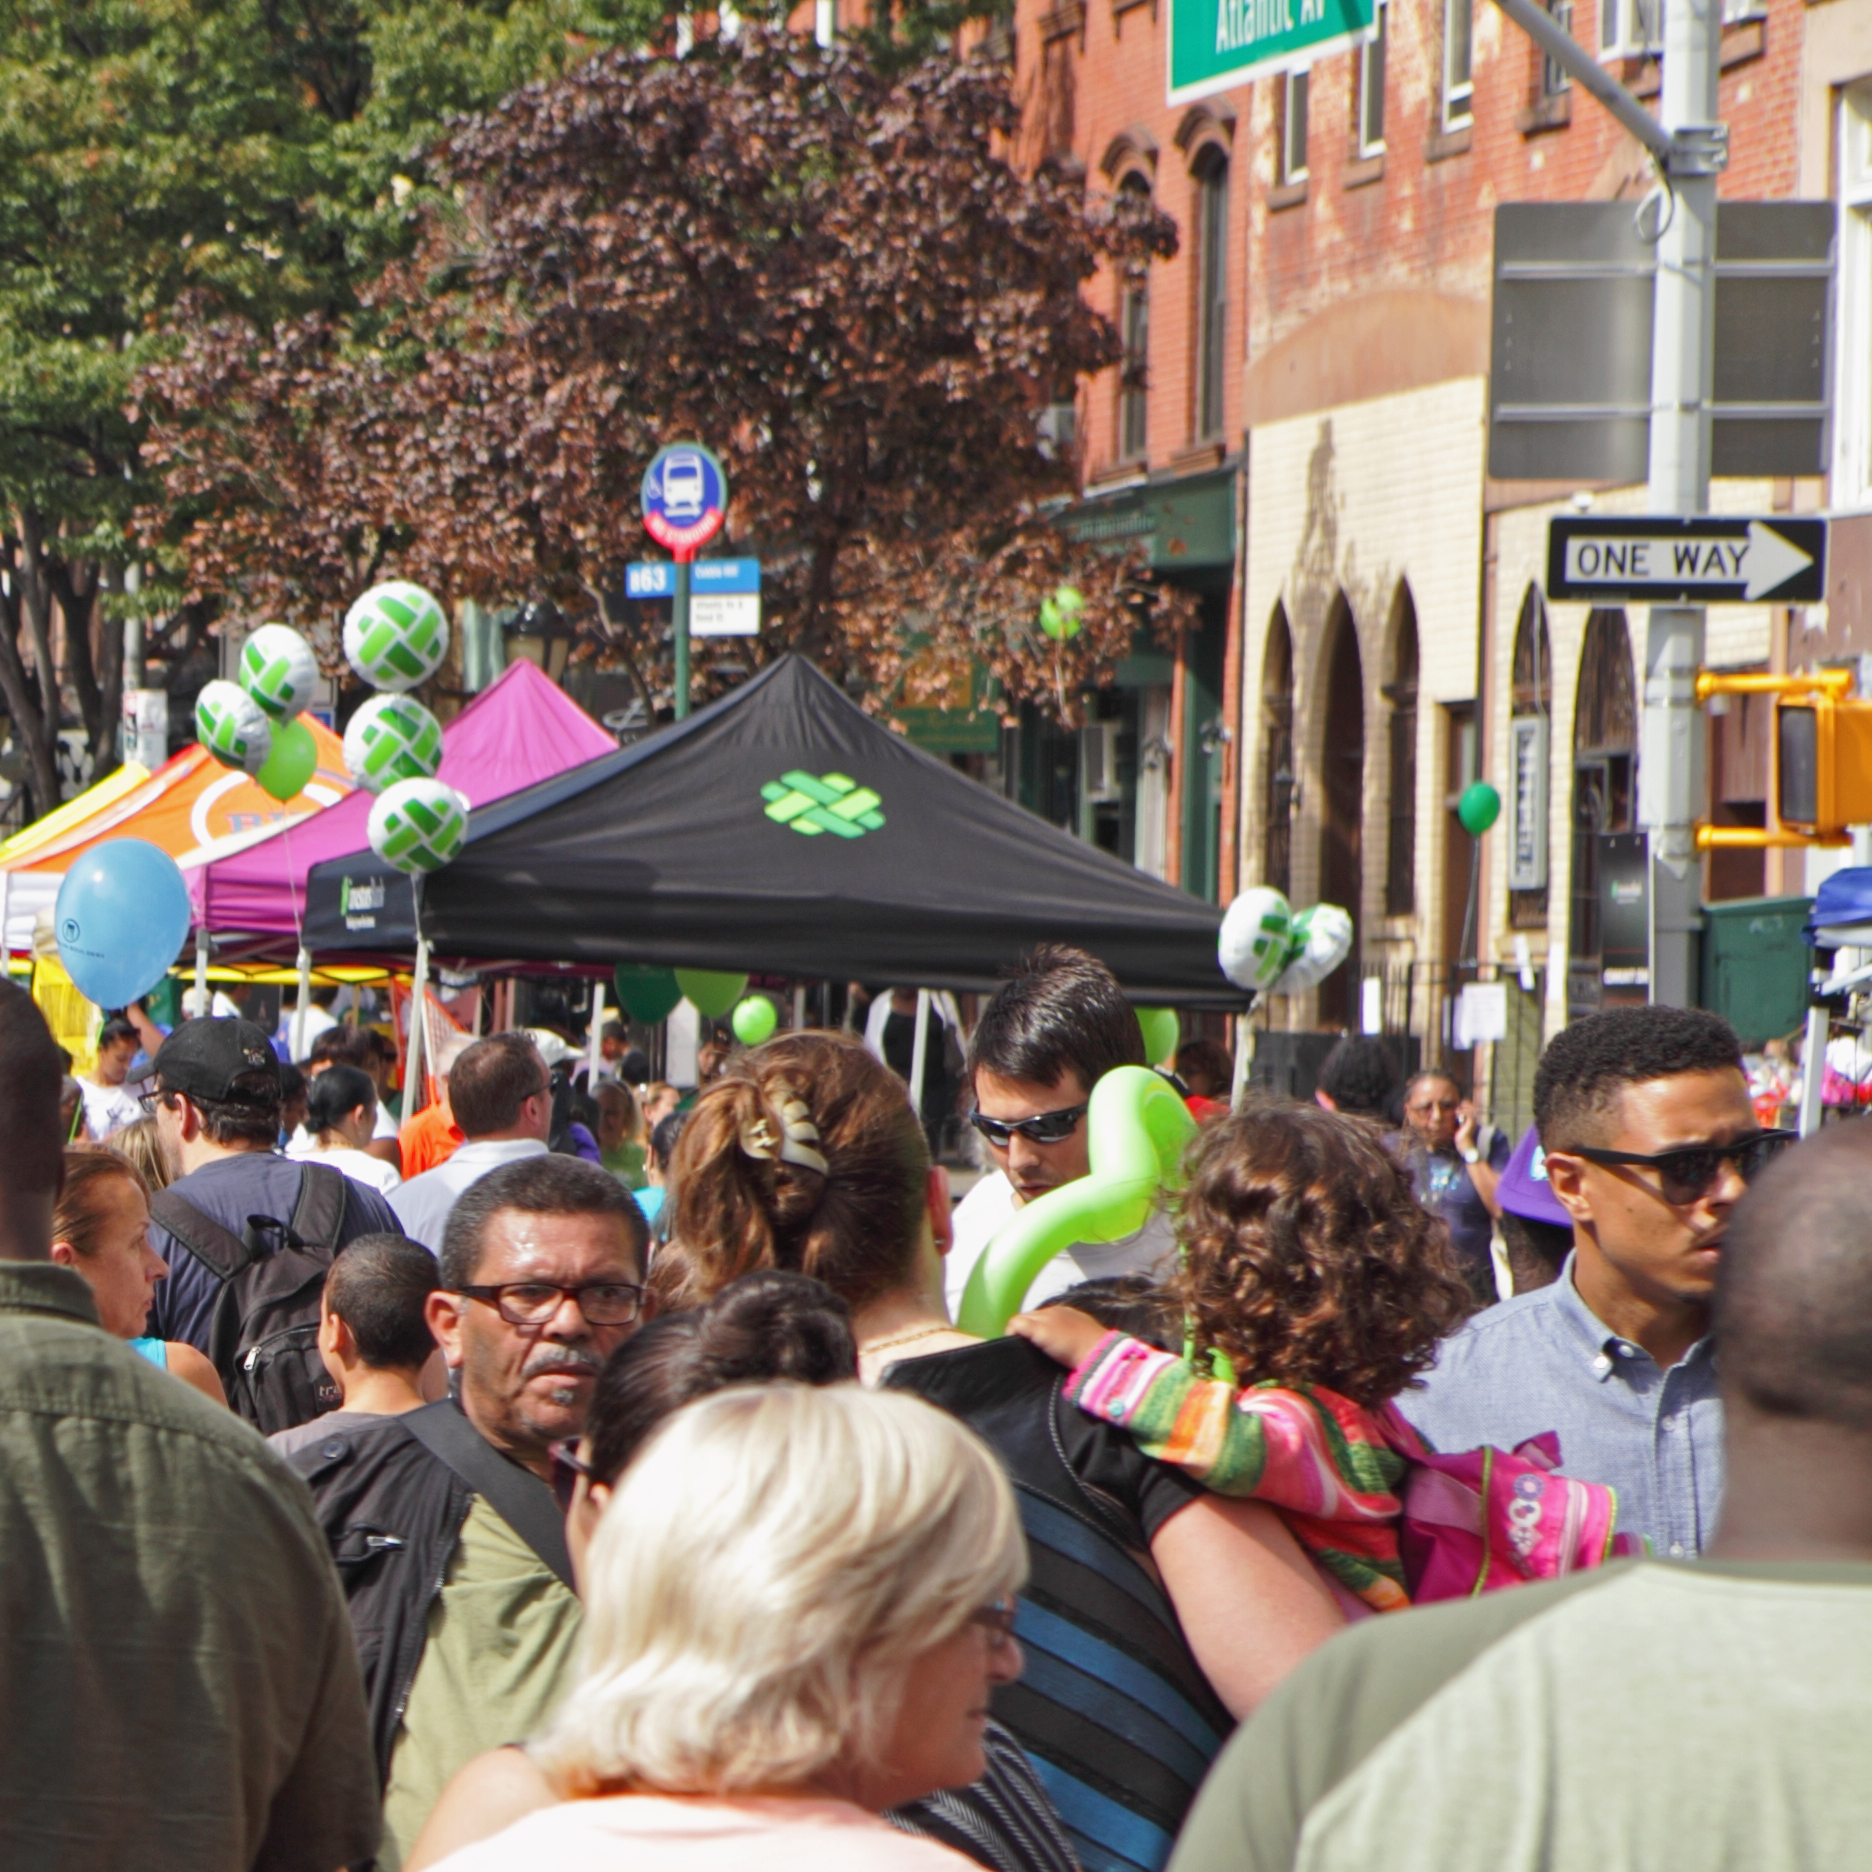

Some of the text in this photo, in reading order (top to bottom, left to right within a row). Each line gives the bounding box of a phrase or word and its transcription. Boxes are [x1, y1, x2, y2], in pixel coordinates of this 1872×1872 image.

[1215, 0, 1294, 54] Atlantic
[664, 508, 718, 544] STANDING
[1577, 541, 1750, 577] ONE WAY
